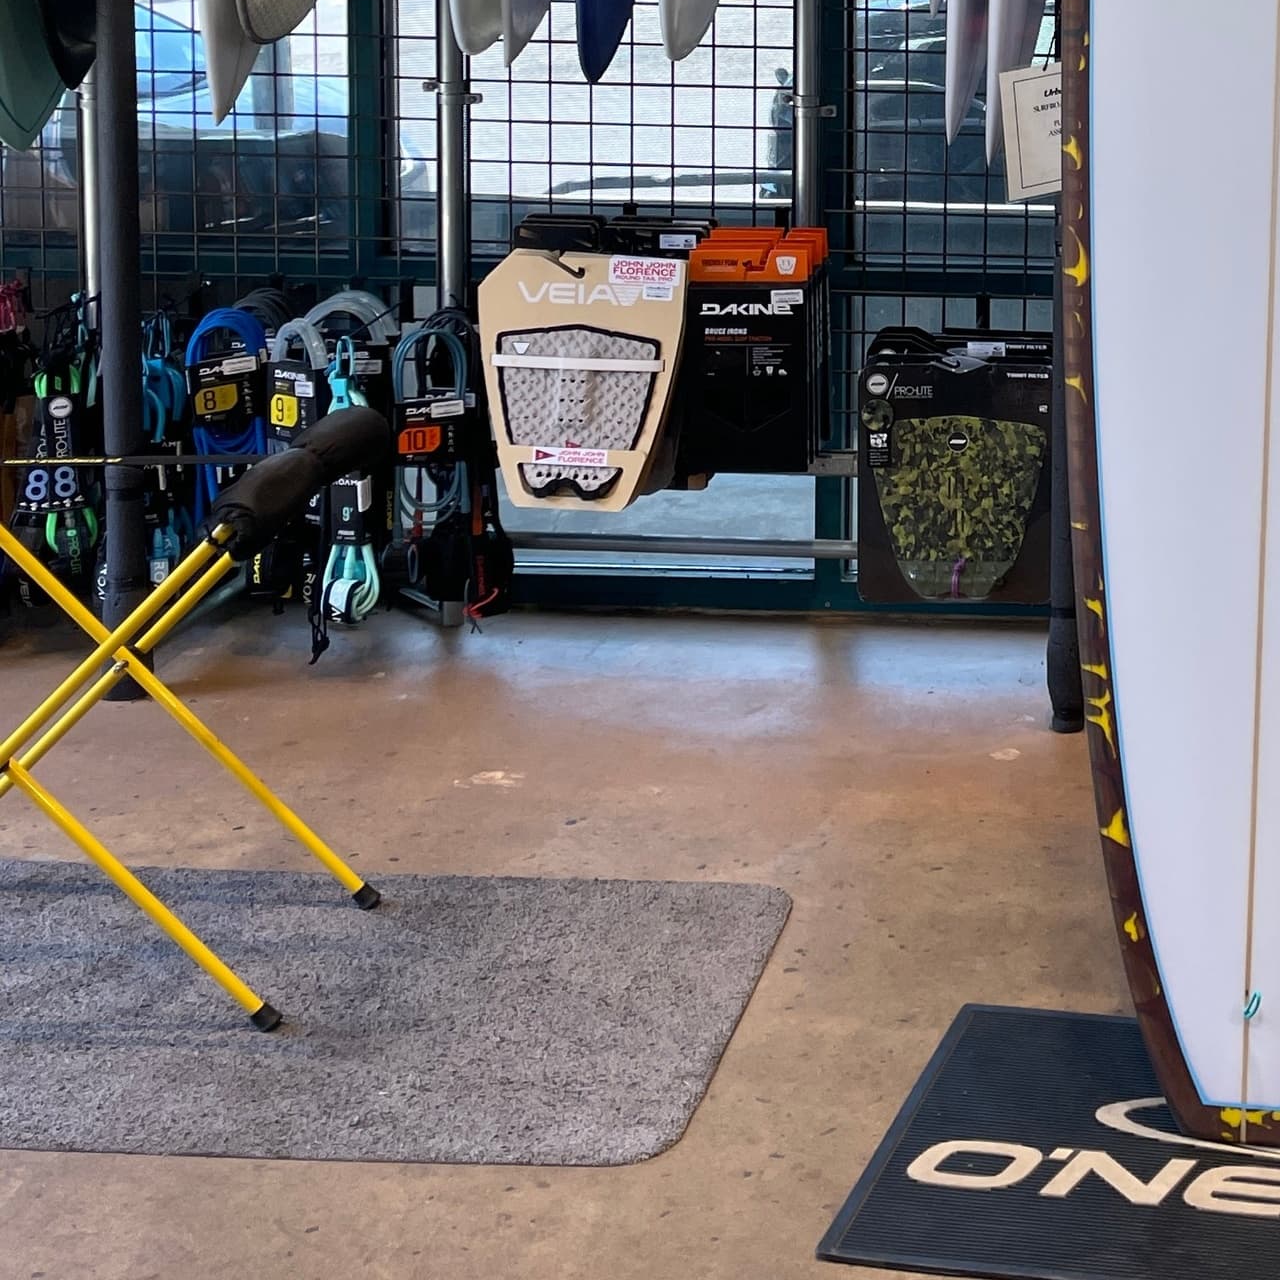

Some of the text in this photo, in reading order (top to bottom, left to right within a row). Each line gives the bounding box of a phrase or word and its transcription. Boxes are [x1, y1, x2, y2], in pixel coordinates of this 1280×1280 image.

[613, 267, 677, 277] FLORENCE
[518, 281, 619, 305] VEIA
[699, 304, 794, 315] DAKINE
[274, 369, 306, 380] DAKINE
[203, 390, 216, 410] 8
[895, 386, 933, 395] PRO-LITE
[276, 397, 284, 422] 9
[406, 430, 426, 451] 10
[558, 456, 604, 464] FLORENCE
[26, 470, 49, 500] 8
[54, 466, 76, 497] 8
